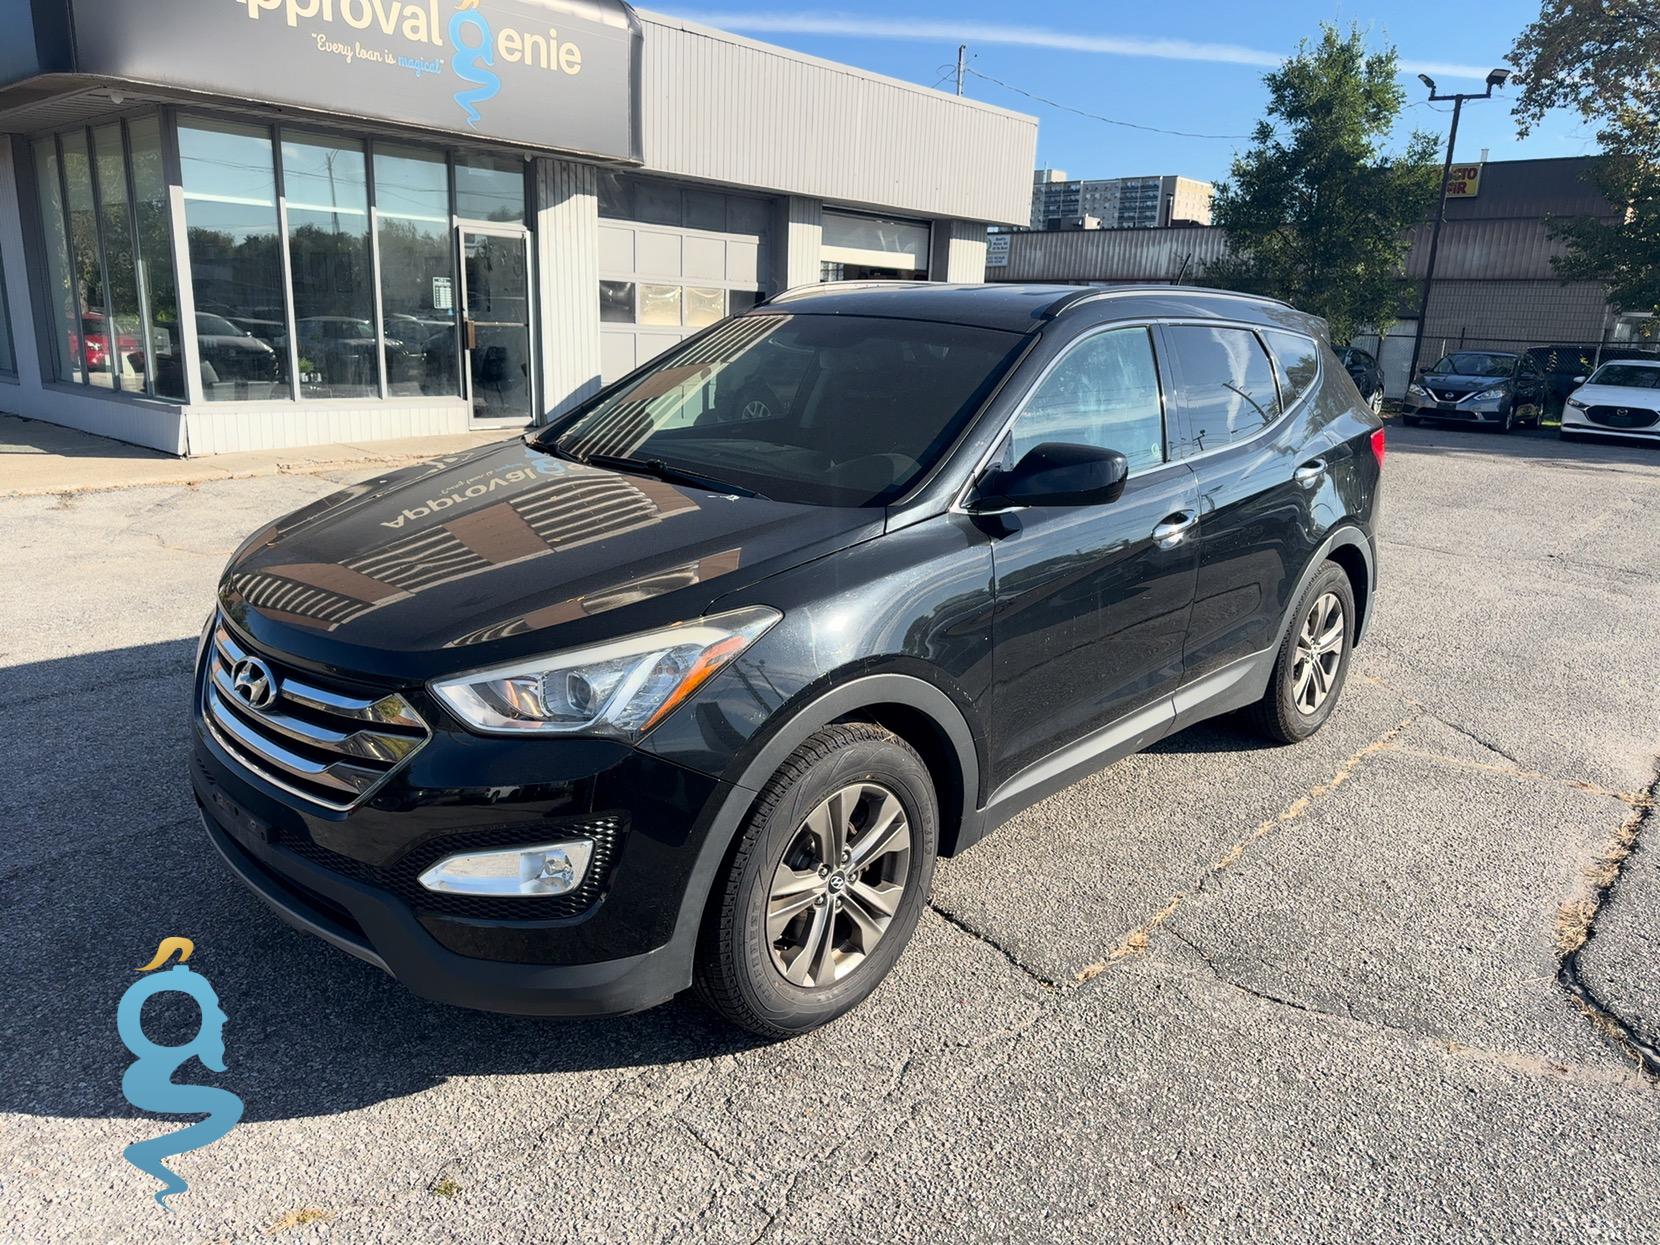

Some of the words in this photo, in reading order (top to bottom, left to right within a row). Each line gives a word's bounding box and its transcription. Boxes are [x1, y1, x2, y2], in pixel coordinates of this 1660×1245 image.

[236, 0, 443, 46] poval
[355, 41, 383, 62] loan
[385, 49, 396, 65] is
